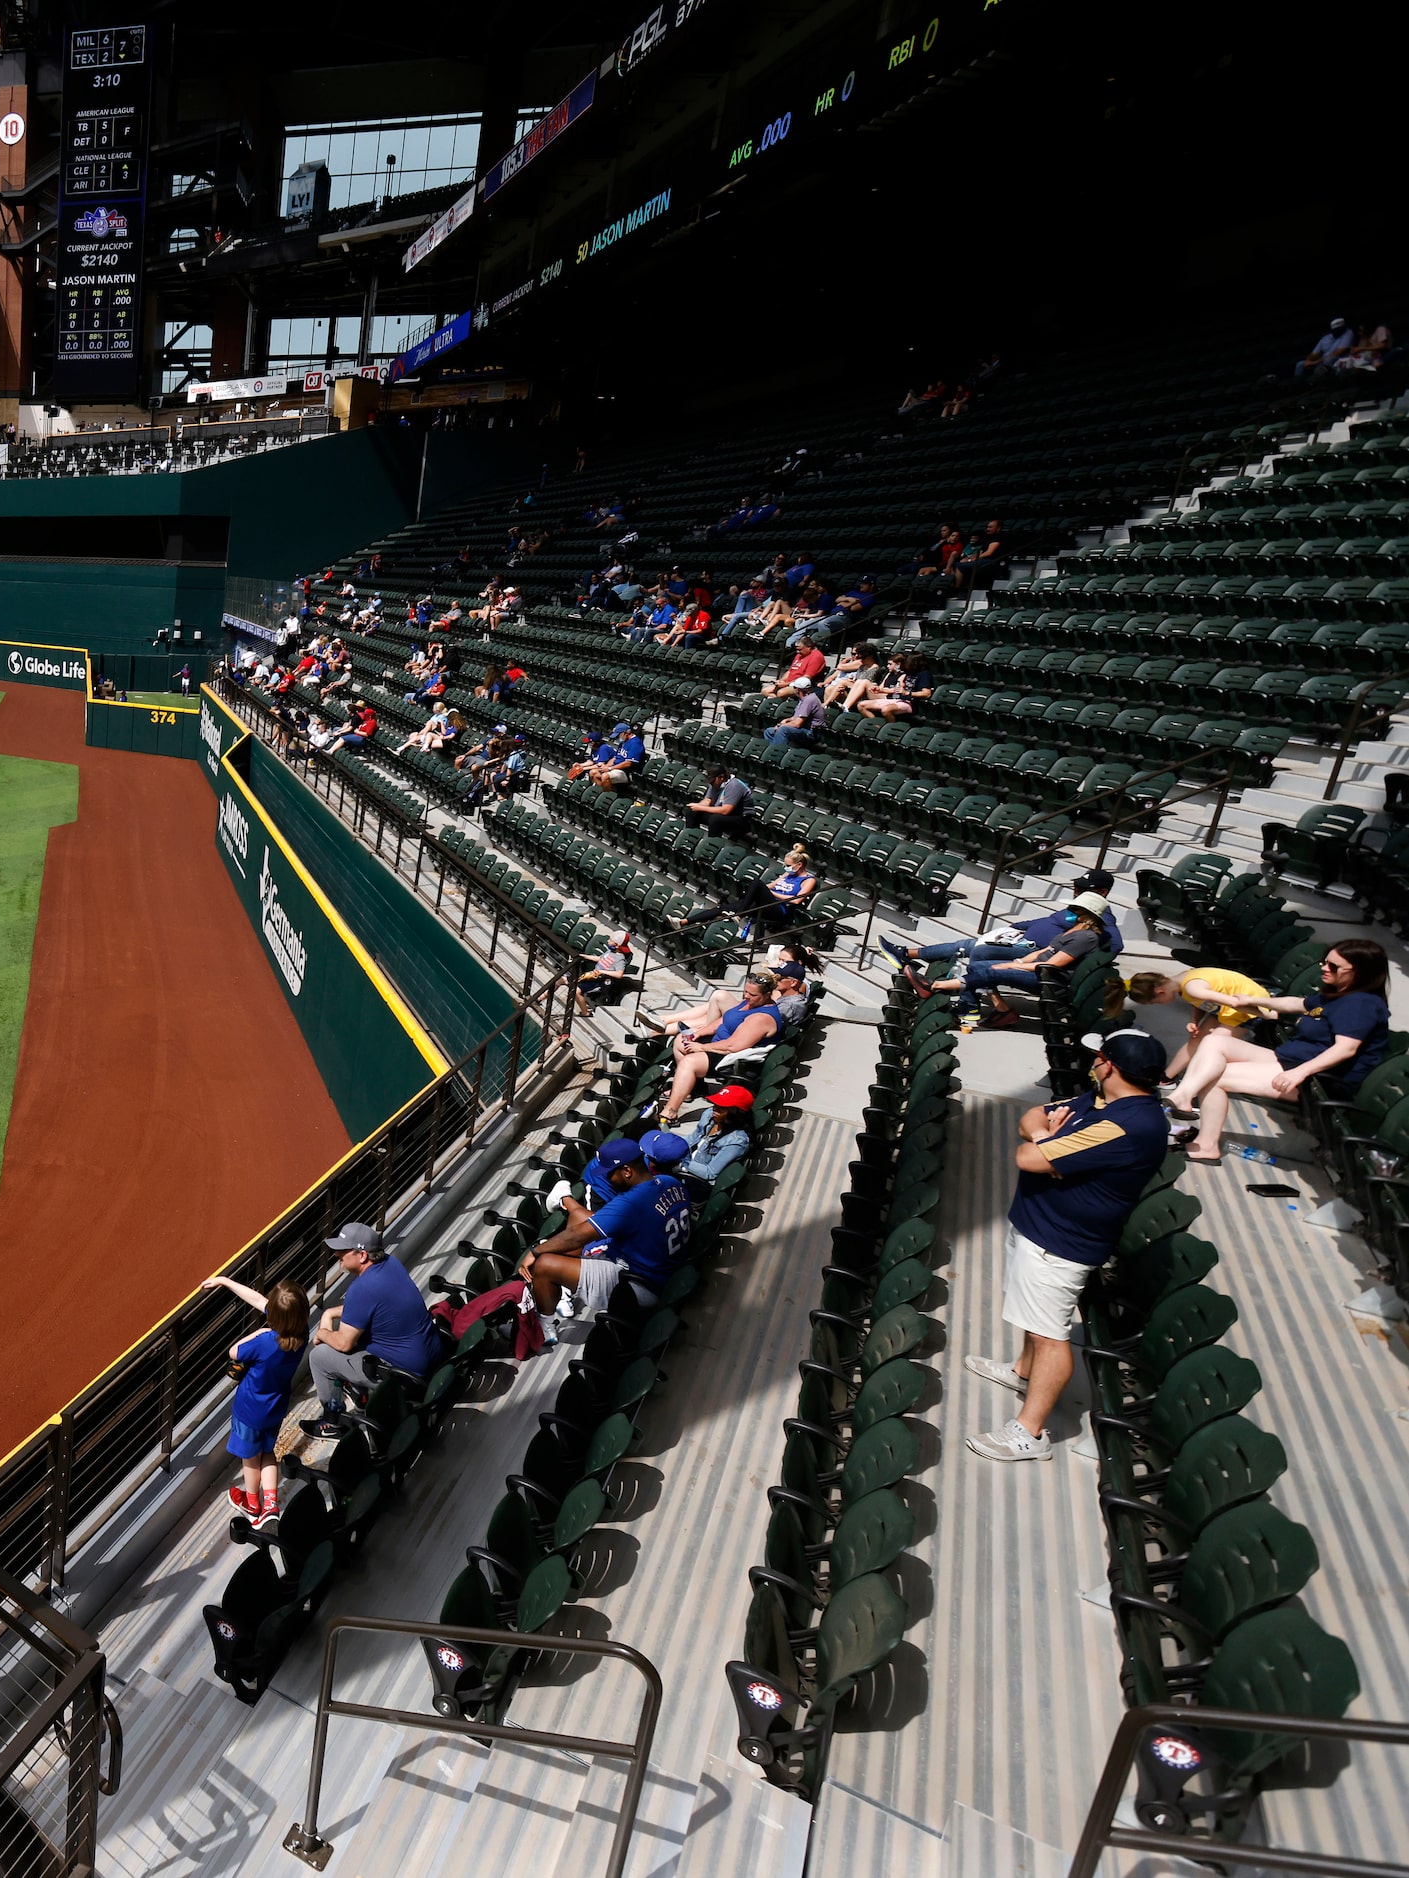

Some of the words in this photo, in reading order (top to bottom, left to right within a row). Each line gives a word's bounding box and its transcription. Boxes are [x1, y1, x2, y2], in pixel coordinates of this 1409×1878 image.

[76, 36, 95, 47] MIL
[103, 34, 110, 44] 6
[120, 41, 126, 51] 7
[888, 35, 915, 70] RBI
[922, 18, 939, 52] 0
[75, 54, 95, 65] TEX
[102, 52, 109, 62] 2
[93, 74, 121, 88] 3:10
[815, 88, 834, 116] HR
[842, 70, 855, 102] 0
[76, 109, 109, 118] AMERICAN
[4, 119, 20, 138] 10
[78, 123, 88, 131] TB
[102, 121, 108, 130] 5
[124, 127, 130, 135] F
[74, 137, 90, 146] DET
[101, 136, 107, 144] 0
[500, 142, 524, 184] 105.3
[526, 121, 546, 162] THE
[546, 97, 571, 144] FAN
[729, 140, 752, 168] AVG
[756, 112, 791, 154] .000
[74, 167, 89, 175] CLE
[100, 165, 106, 174] 2
[123, 171, 128, 180] 3
[73, 180, 88, 190] ARI
[100, 179, 105, 188] 0
[576, 240, 588, 265] 50
[590, 217, 624, 256] JASON
[625, 188, 671, 235] MARTIN
[67, 244, 99, 252] CURRENT
[100, 242, 133, 250] JACKPOT
[81, 254, 118, 267] $2140
[62, 276, 95, 286] JASON
[98, 274, 136, 284] MARTIN
[113, 296, 132, 305] .000
[492, 292, 512, 313] CURRENT
[512, 279, 534, 302] JACKPOT
[111, 341, 130, 349] .000
[435, 328, 453, 352] ULTRA
[307, 375, 320, 387] QT
[216, 383, 249, 392] DISPLAYS
[25, 657, 60, 676] Globe
[62, 661, 86, 679] Life
[150, 711, 176, 725] 374
[270, 876, 306, 980] Germania
[655, 1186, 686, 1216] BELTRE
[665, 1208, 691, 1255] 29
[442, 1703, 448, 1712] 2
[751, 1746, 758, 1756] 3
[1154, 1814, 1166, 1825] 4
